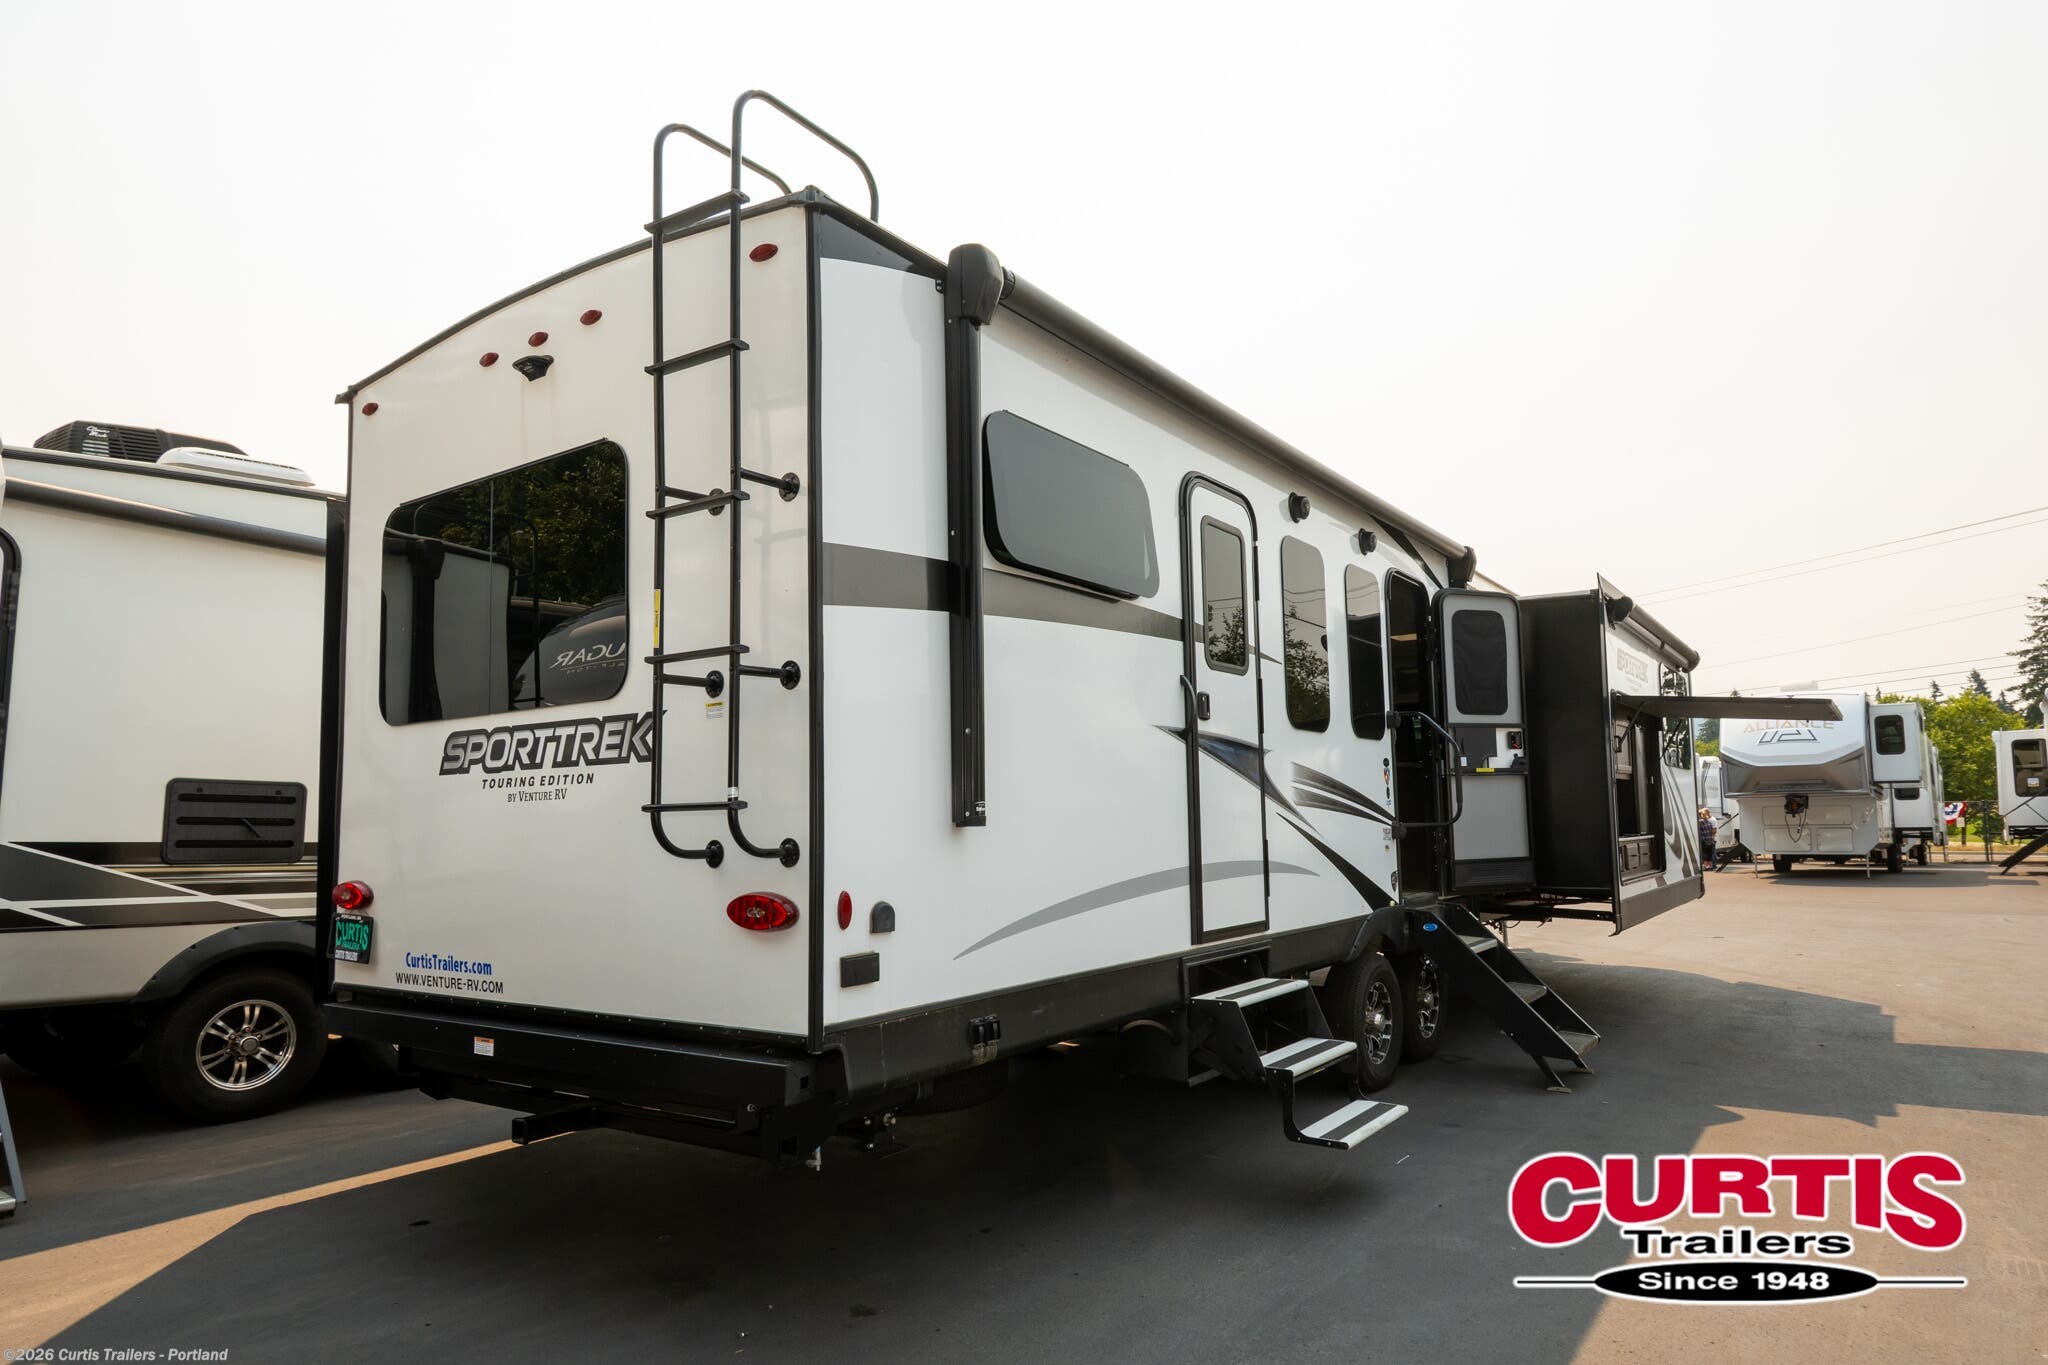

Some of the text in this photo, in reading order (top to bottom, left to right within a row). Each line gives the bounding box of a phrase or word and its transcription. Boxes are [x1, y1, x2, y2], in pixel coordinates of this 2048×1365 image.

[439, 709, 667, 776] SPORTTREK
[482, 773, 595, 789] TOURING EDITION
[554, 788, 567, 800] RV
[335, 921, 369, 950] CURTIS
[405, 952, 492, 976] CurtisTrailers.com
[395, 972, 504, 994] WWW.VENTURE-RV.COM
